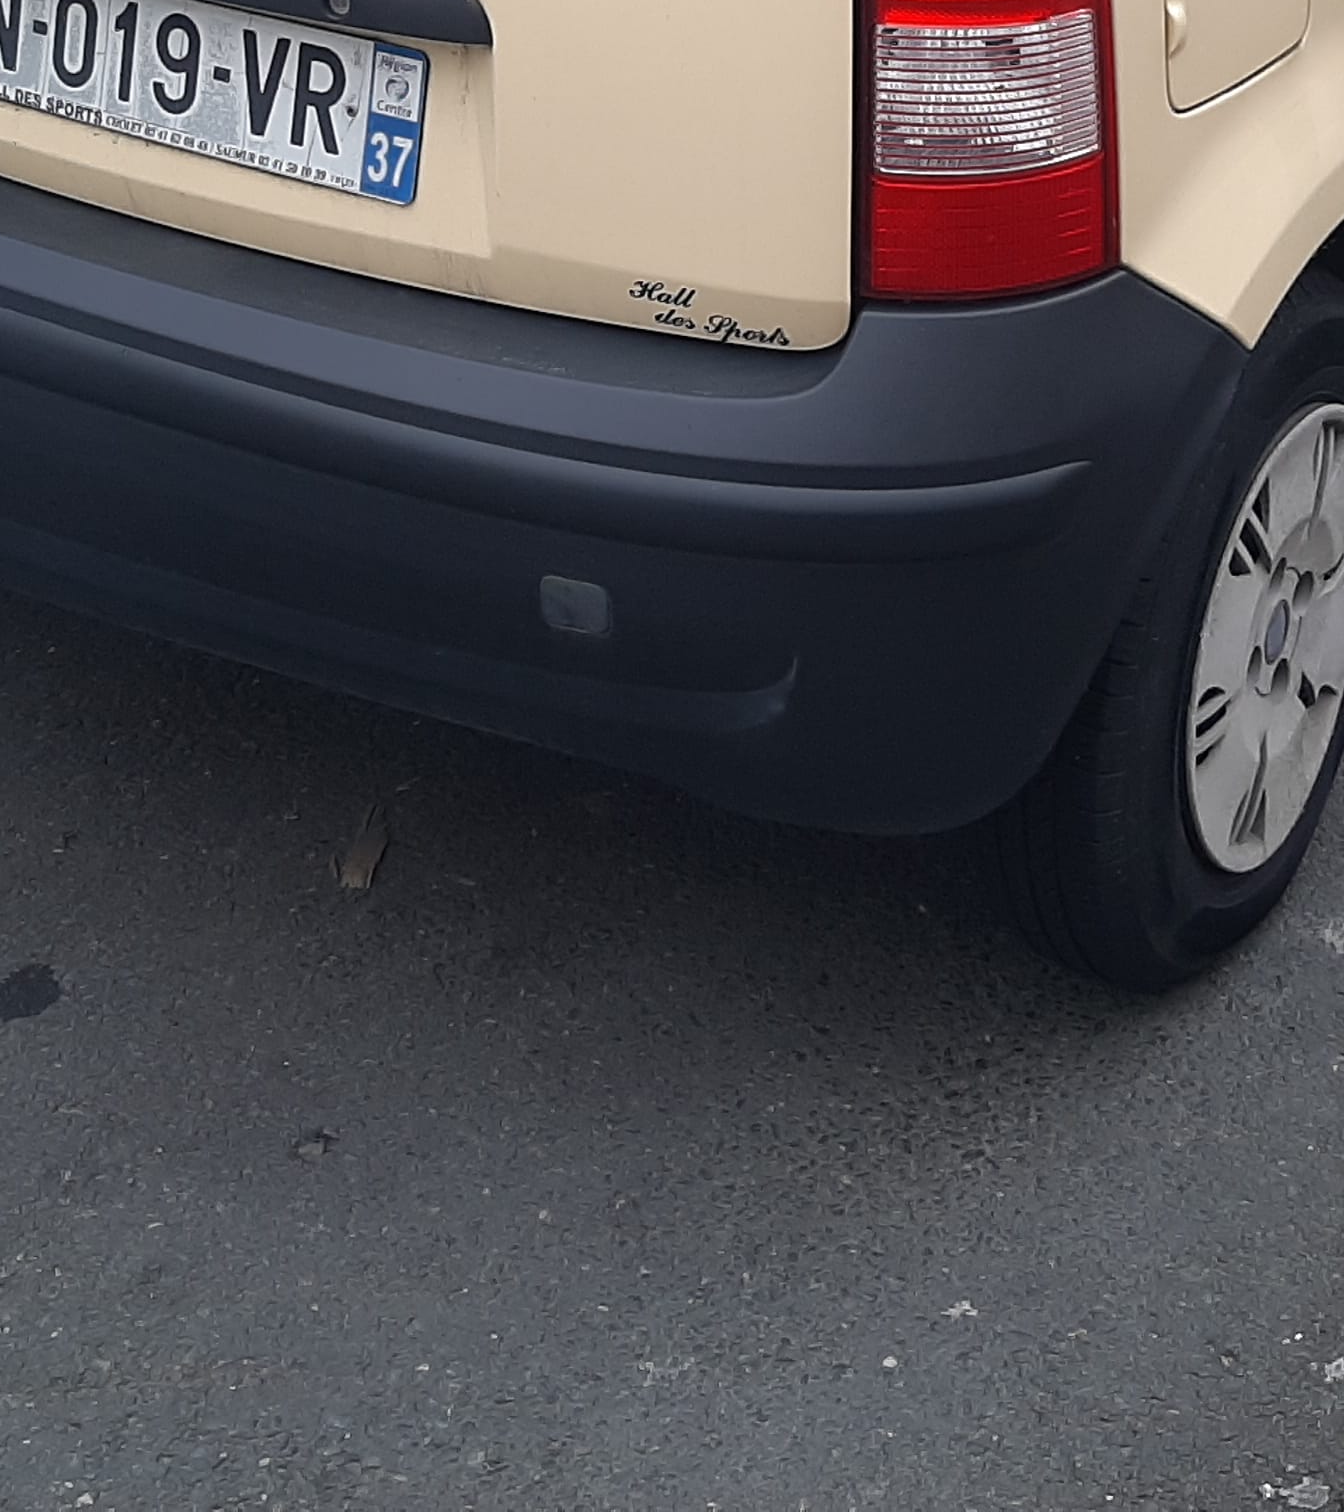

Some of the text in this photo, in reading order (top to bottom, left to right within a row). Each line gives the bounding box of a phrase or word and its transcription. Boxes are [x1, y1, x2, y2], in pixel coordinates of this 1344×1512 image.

[46, 95, 103, 127] SPORTS
[367, 131, 414, 188] 37
[629, 280, 696, 308] Hall
[654, 309, 791, 346] des Sports
